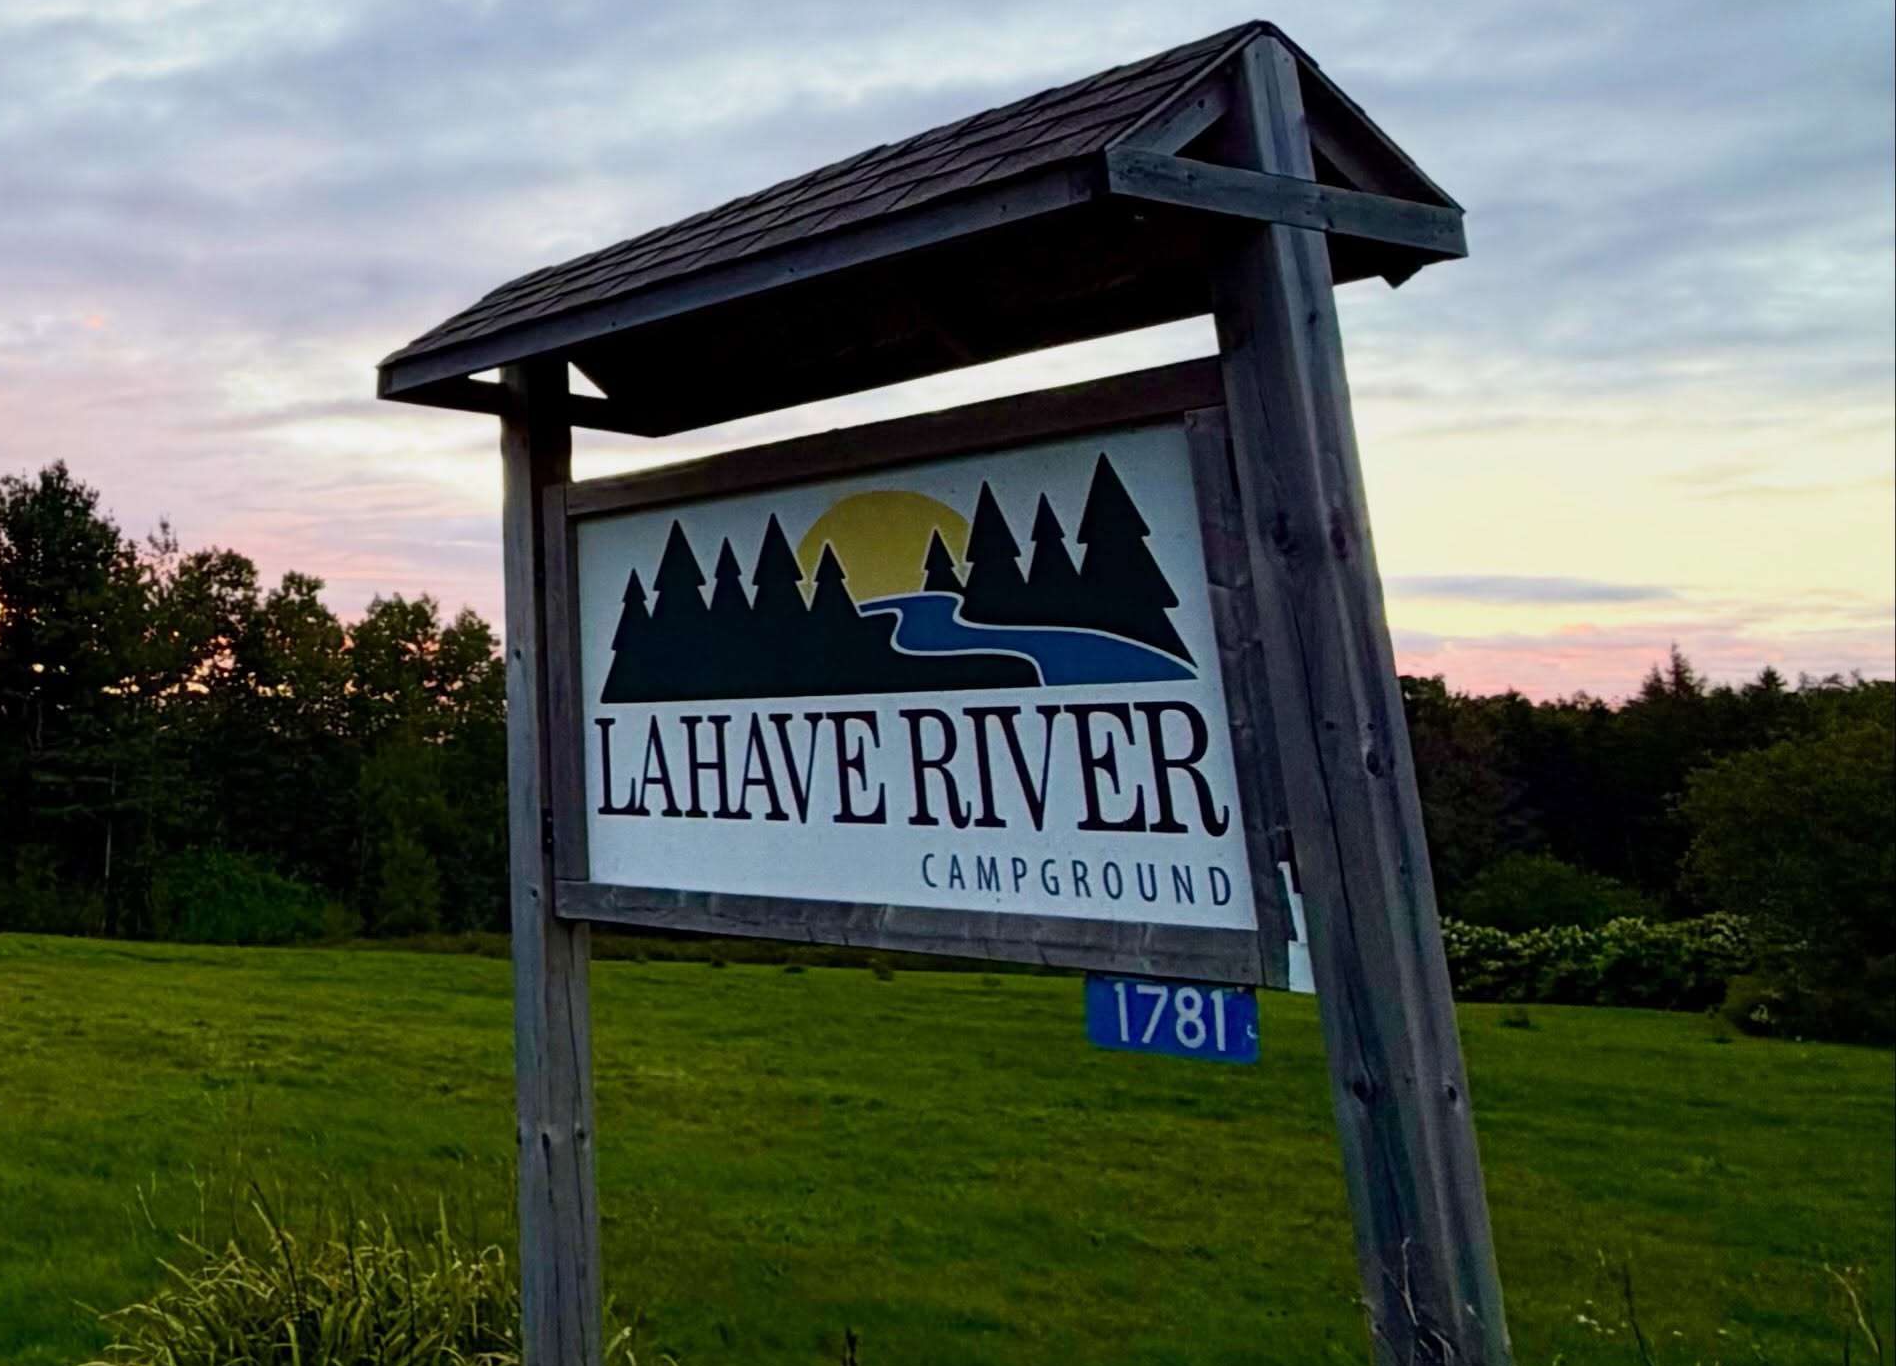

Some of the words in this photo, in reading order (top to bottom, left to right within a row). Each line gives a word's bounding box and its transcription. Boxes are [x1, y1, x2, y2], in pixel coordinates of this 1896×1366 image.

[594, 710, 887, 825] LAHAVE
[899, 699, 1229, 837] RIVER
[921, 852, 1232, 907] CAMPGROUND
[1113, 981, 1227, 1053] 1781
